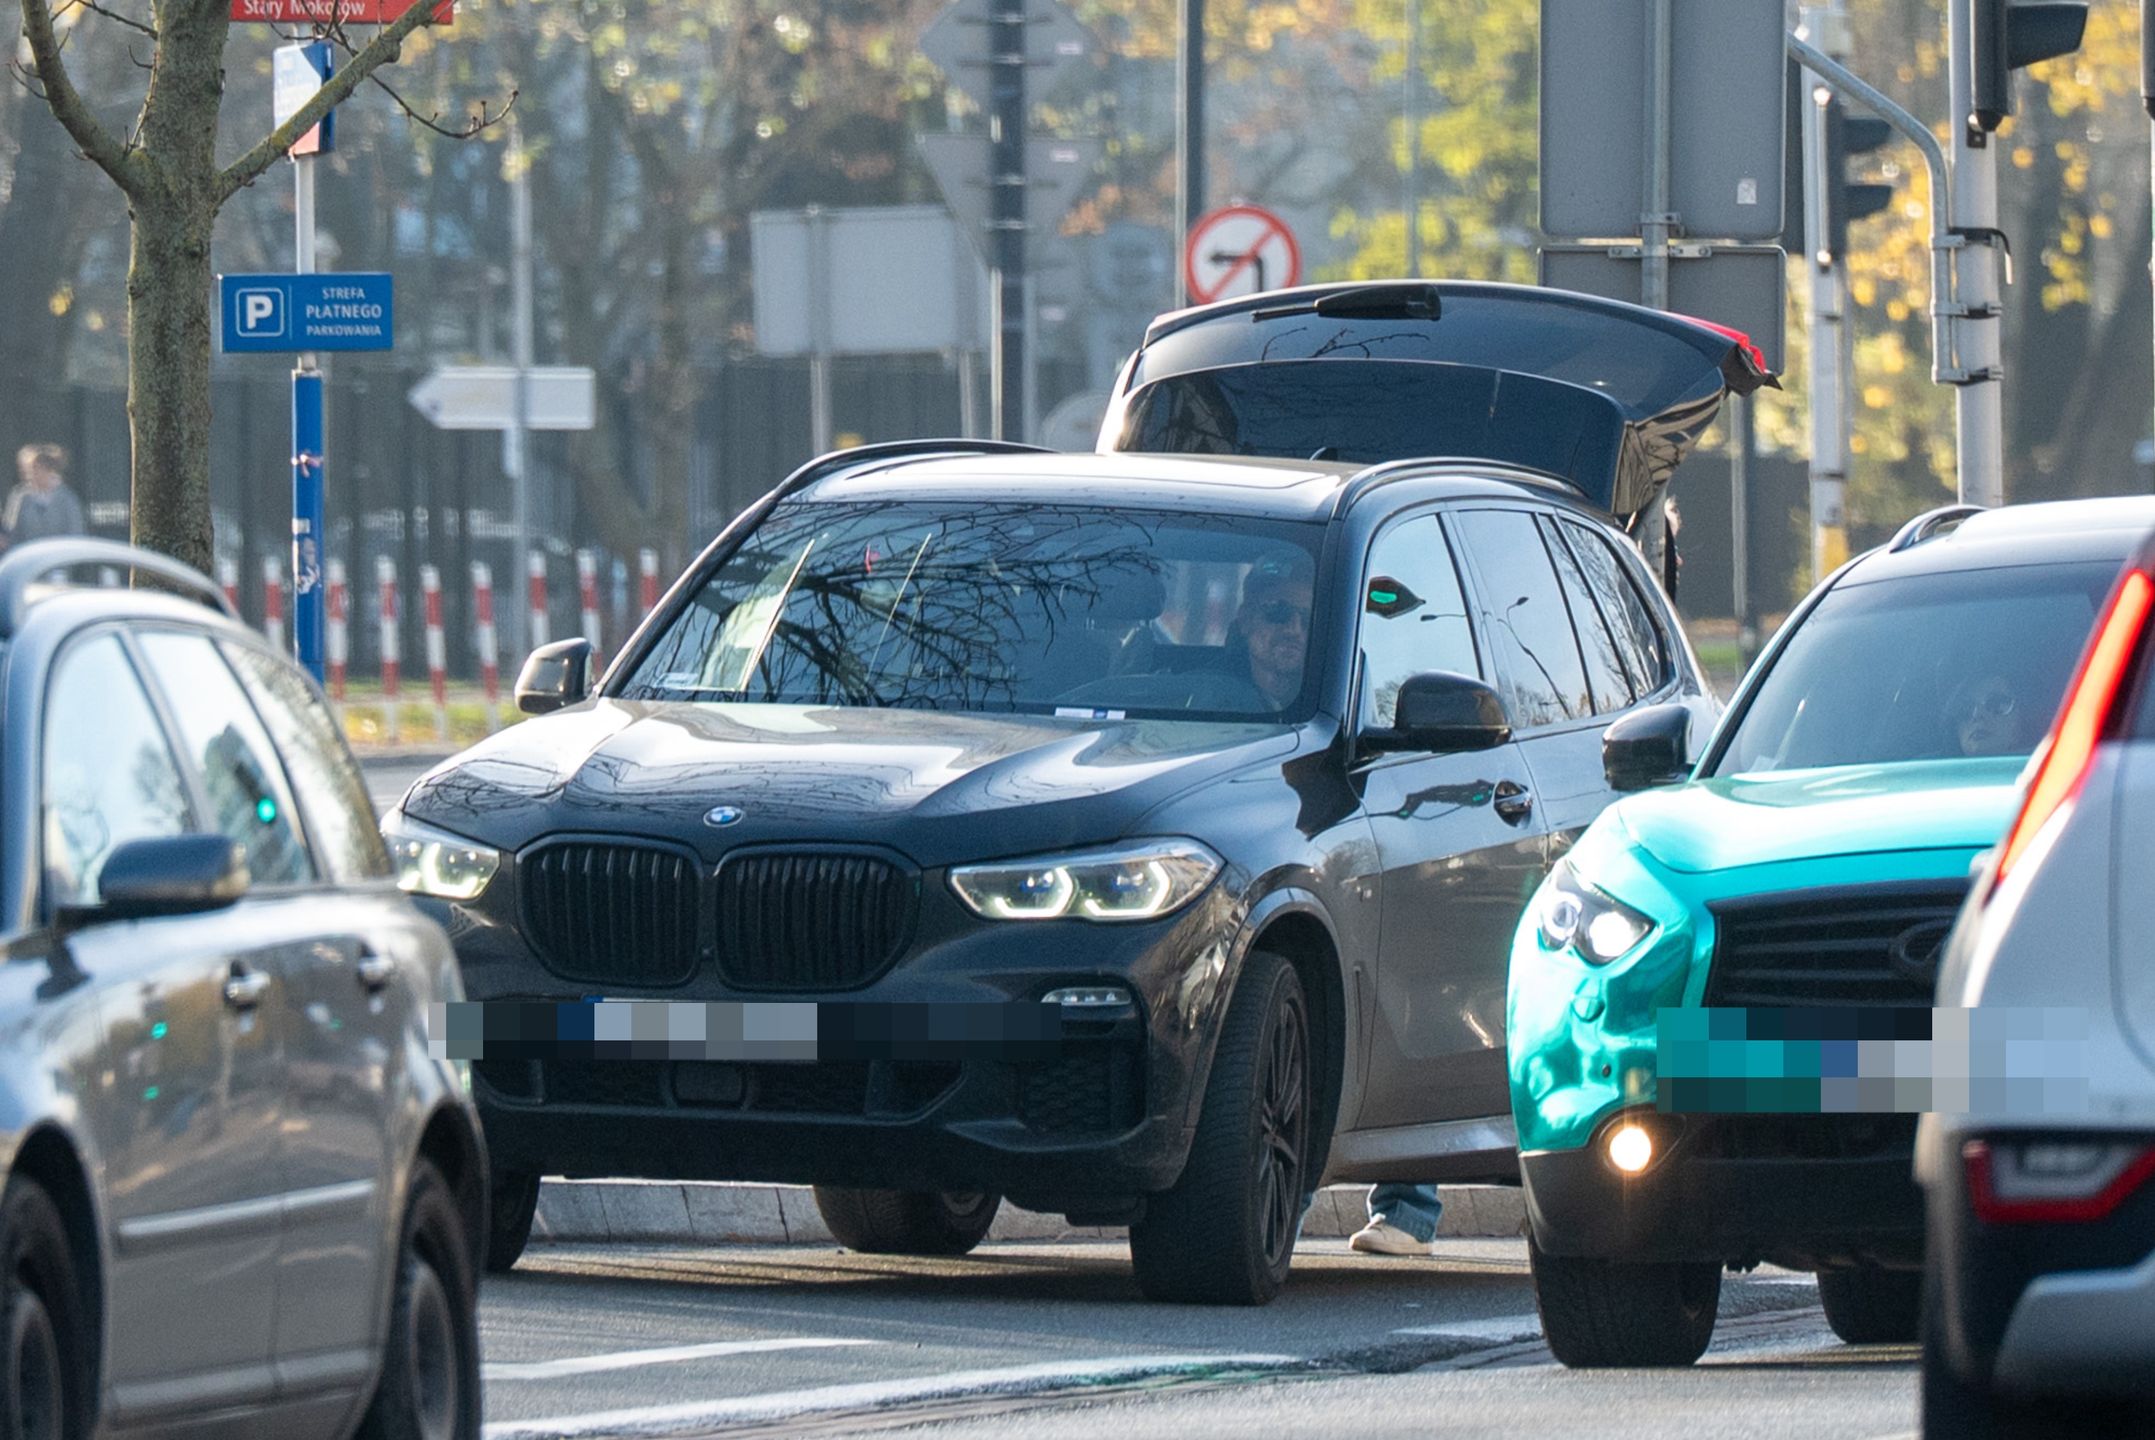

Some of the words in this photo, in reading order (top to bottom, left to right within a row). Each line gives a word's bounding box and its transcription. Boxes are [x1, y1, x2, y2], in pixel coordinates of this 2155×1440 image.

[244, 0, 283, 19] Stary
[322, 287, 365, 300] STREFA
[246, 295, 273, 330] P
[306, 303, 382, 319] PŁATNEGO
[306, 325, 382, 336] PARKOWANIA
